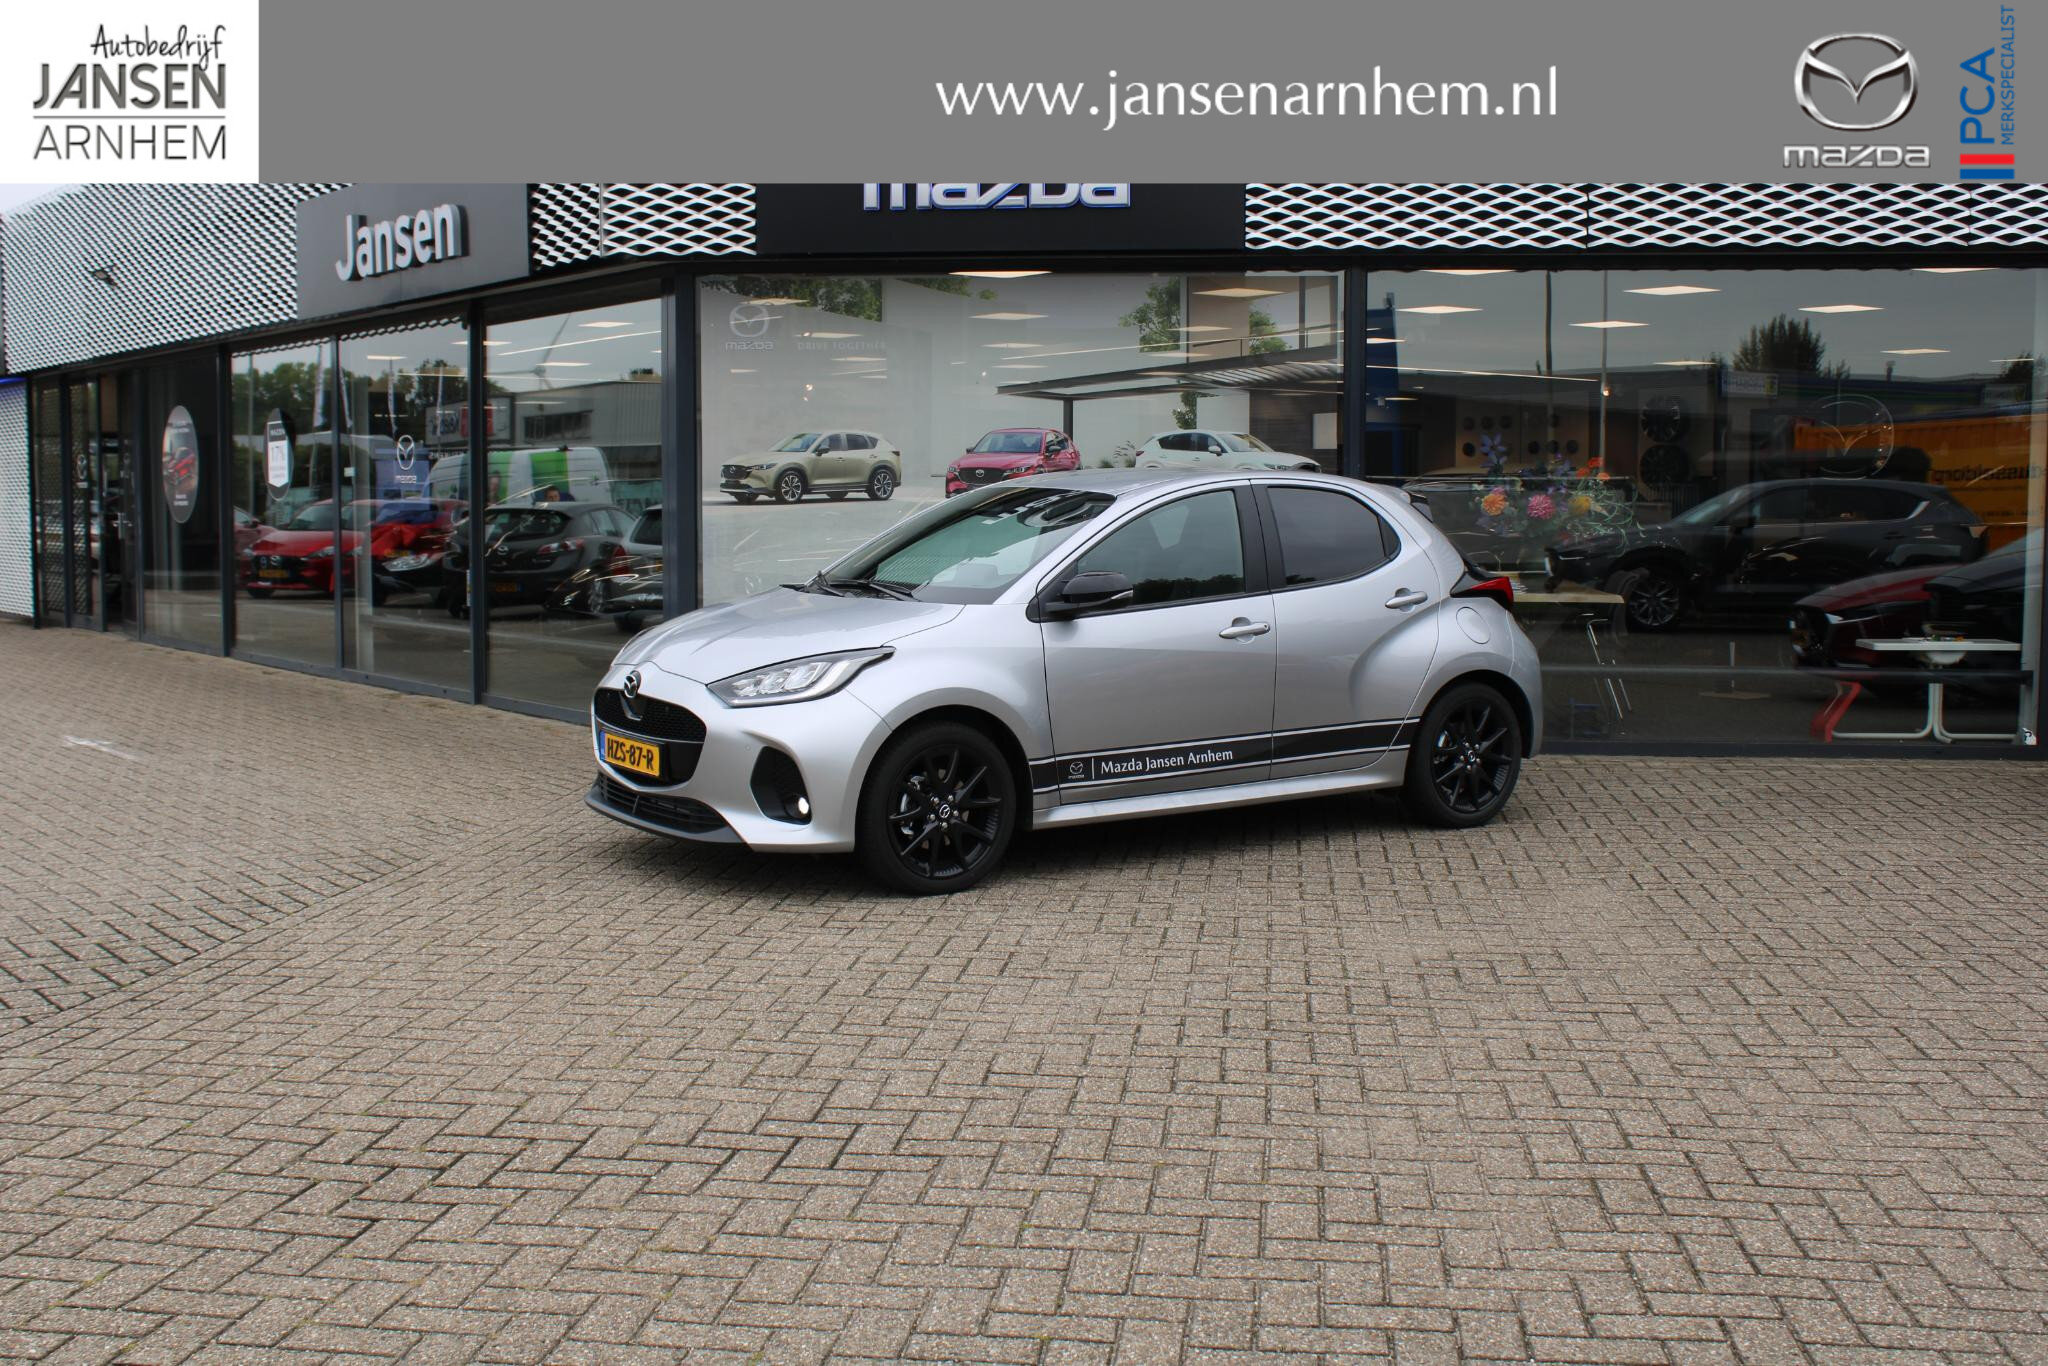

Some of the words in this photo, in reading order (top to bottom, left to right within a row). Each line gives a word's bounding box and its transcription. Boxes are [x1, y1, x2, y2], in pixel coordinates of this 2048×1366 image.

[335, 203, 462, 282] Jansen
[607, 737, 654, 771] HZS-87-R
[1101, 758, 1143, 774] Mazda
[1145, 756, 1185, 771] Jansen
[1187, 749, 1233, 764] Arnhem
